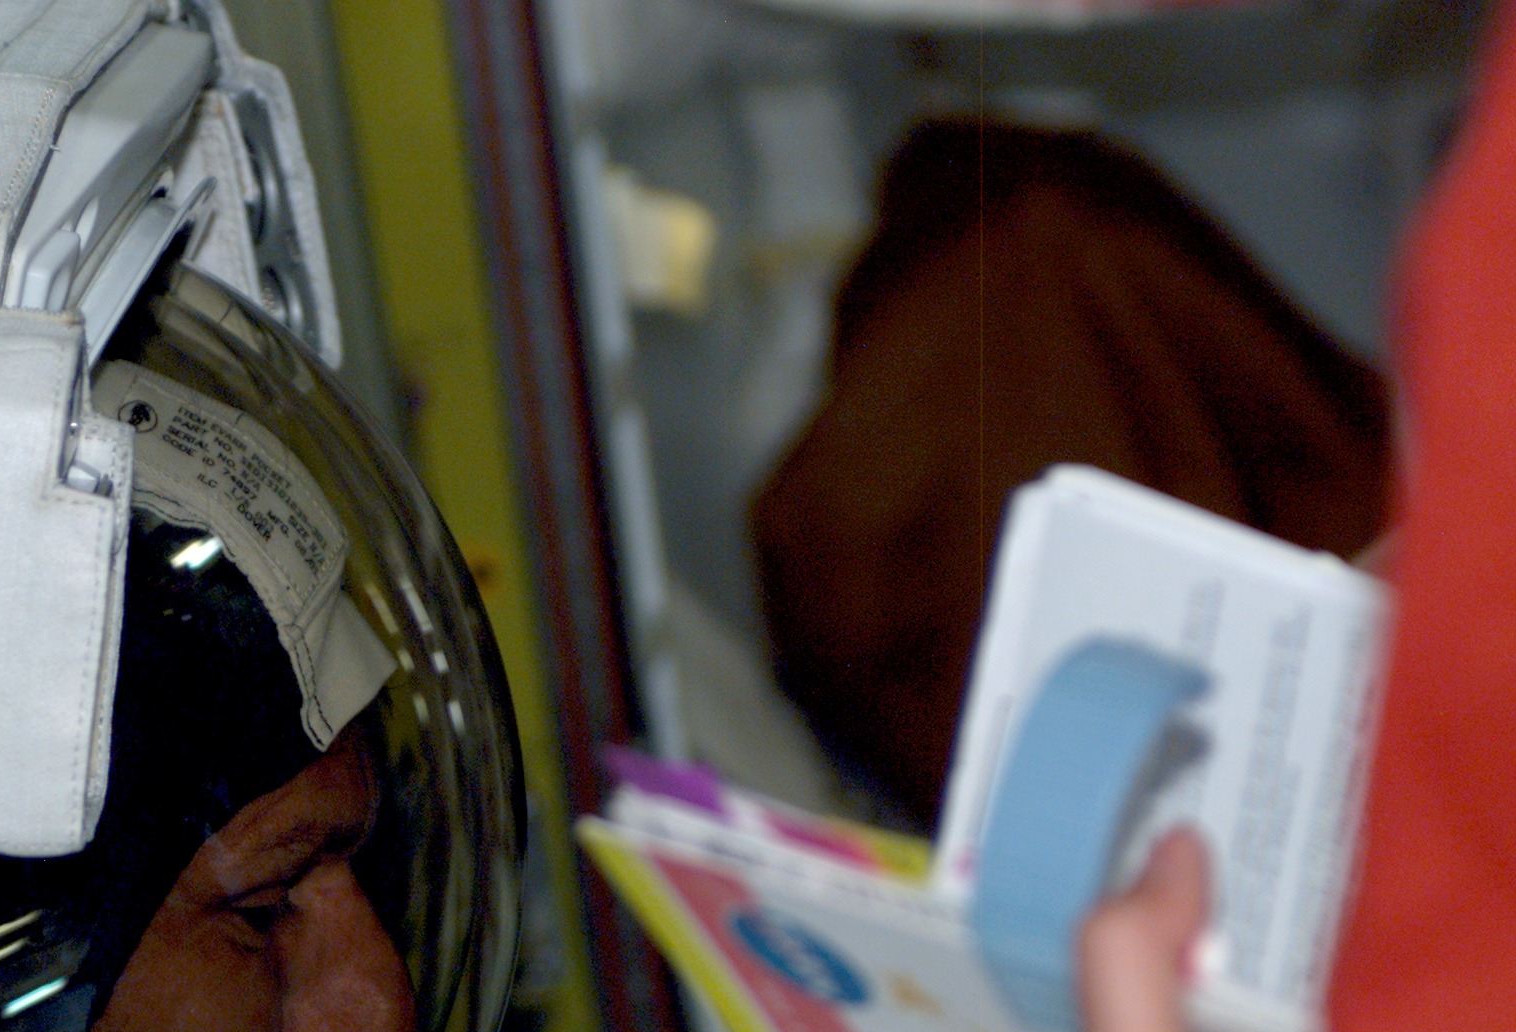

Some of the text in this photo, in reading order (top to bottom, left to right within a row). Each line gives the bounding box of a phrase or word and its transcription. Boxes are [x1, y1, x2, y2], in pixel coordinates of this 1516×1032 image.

[162, 434, 195, 456] CODE
[169, 426, 210, 451] SERIAL
[218, 452, 239, 470] NO.
[172, 415, 208, 435] PART
[213, 436, 234, 455] NO.
[197, 473, 272, 542] ILC DOVER
